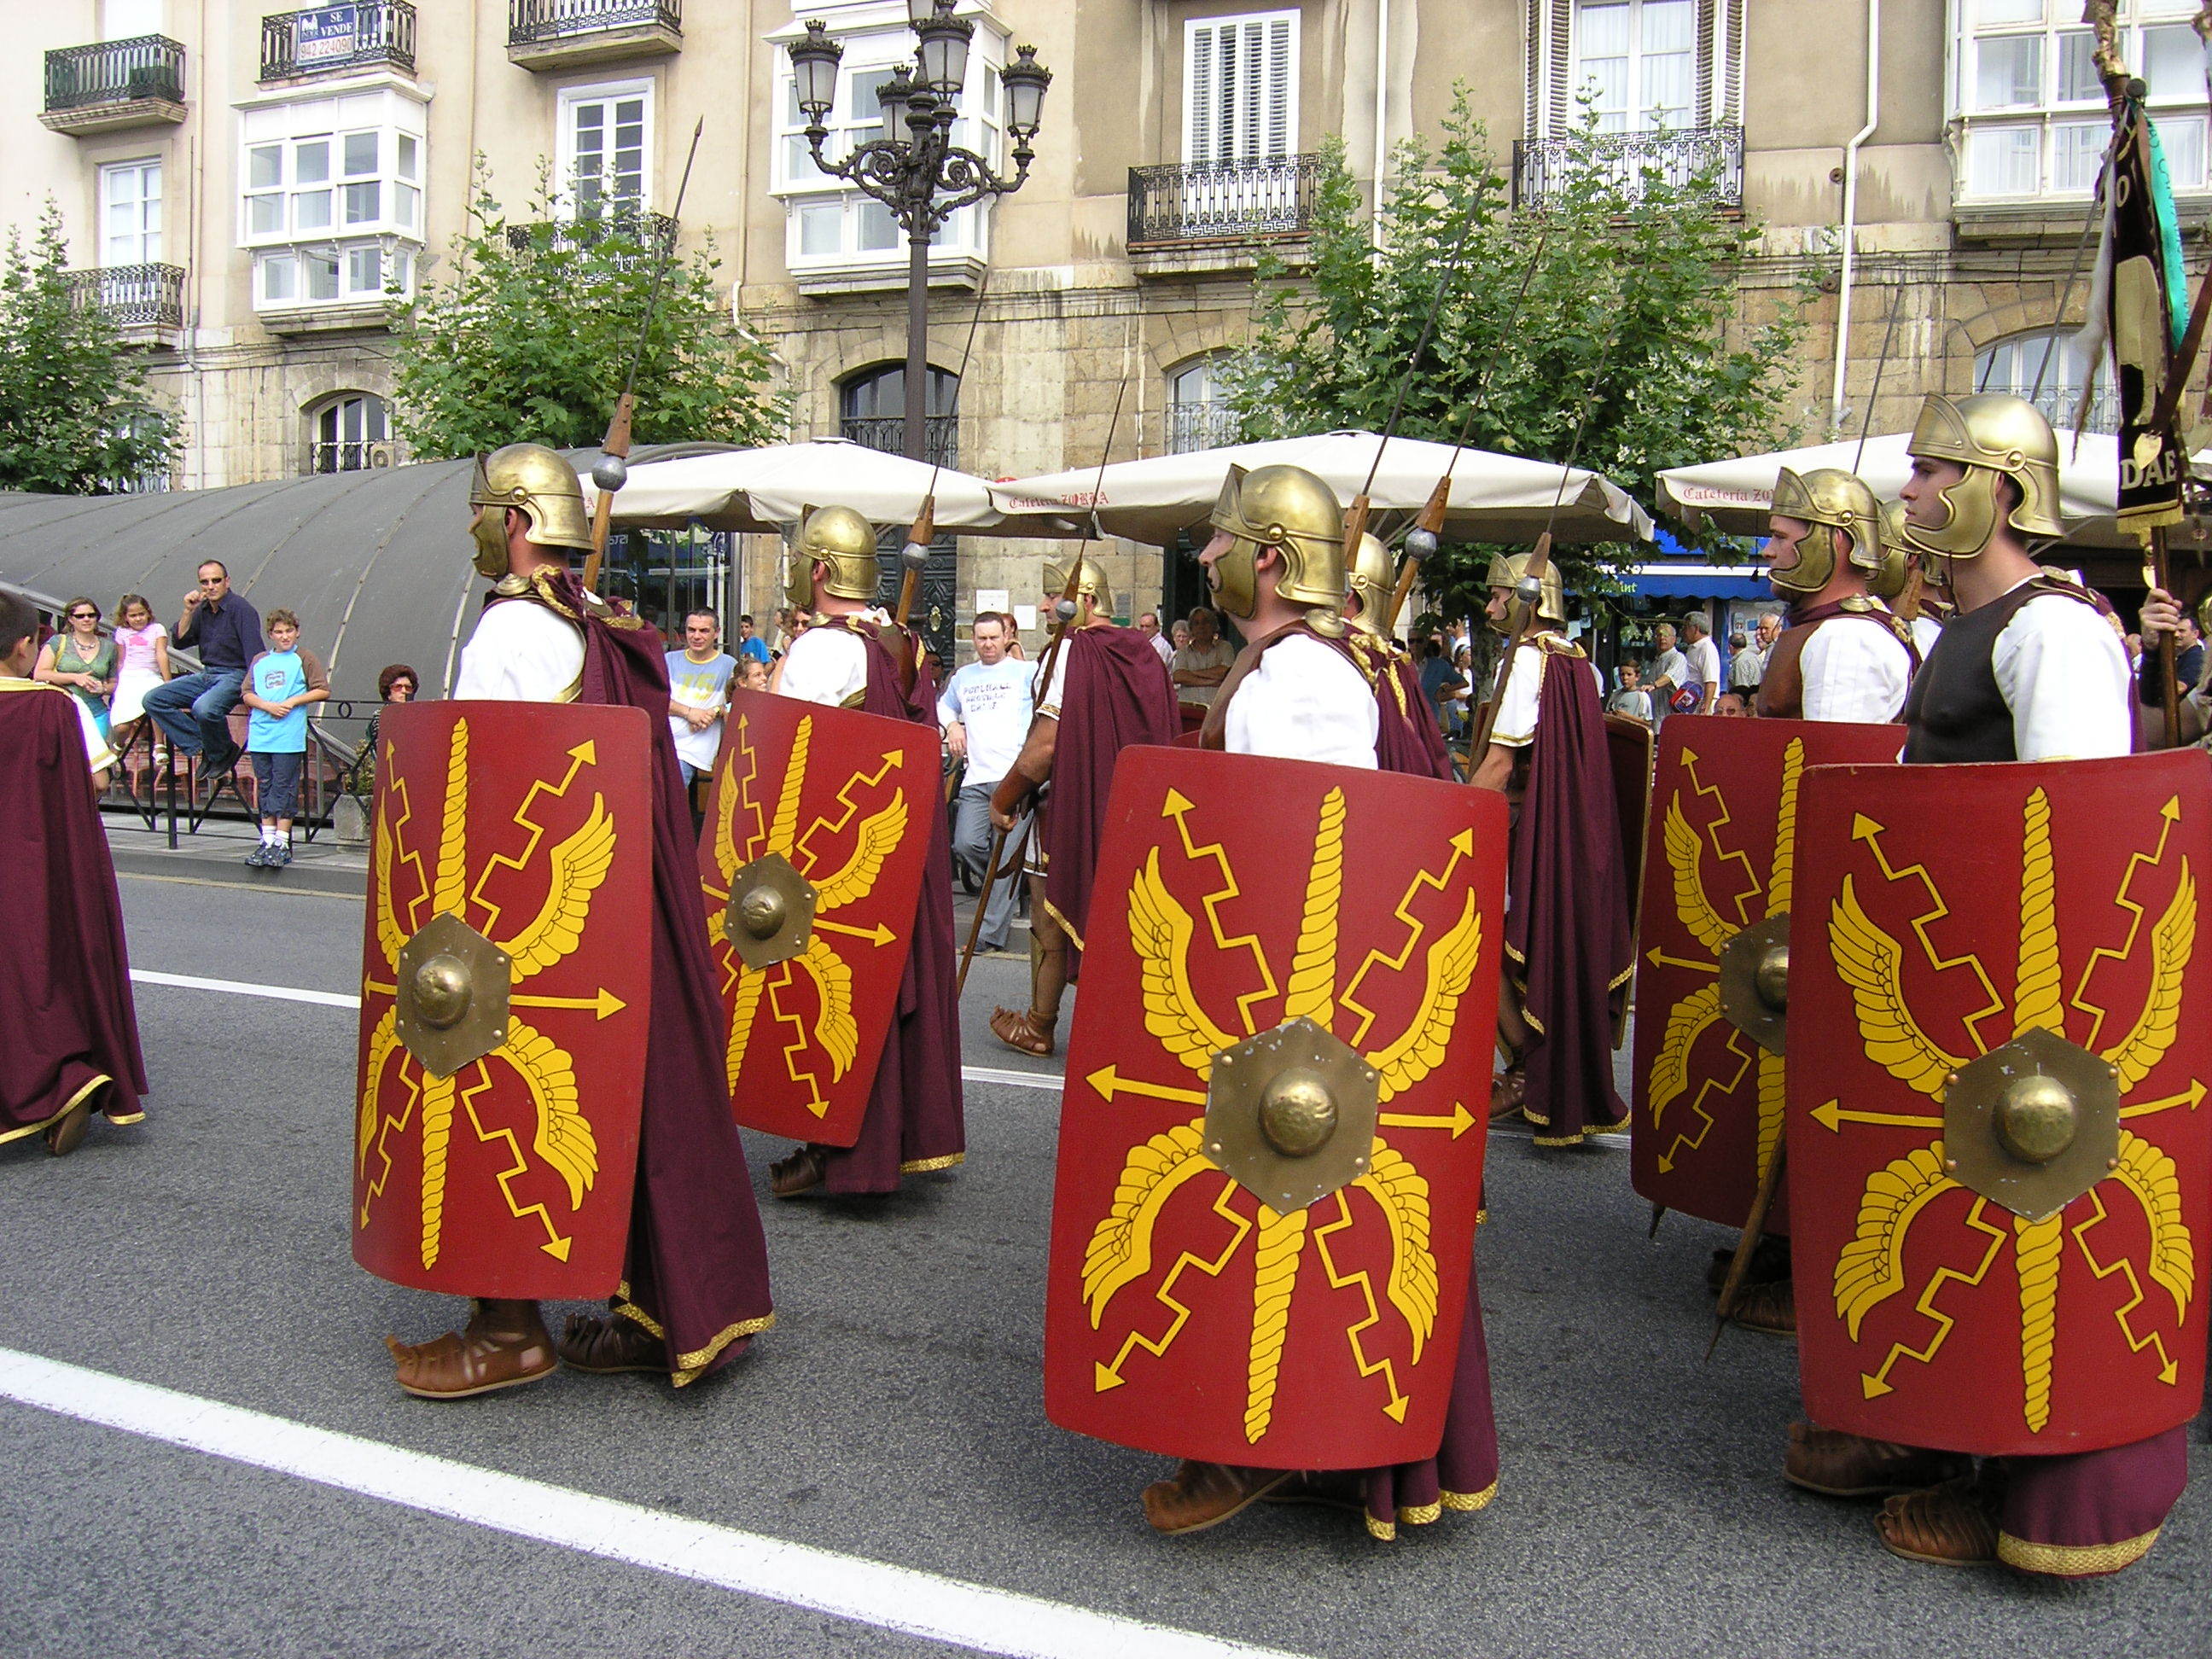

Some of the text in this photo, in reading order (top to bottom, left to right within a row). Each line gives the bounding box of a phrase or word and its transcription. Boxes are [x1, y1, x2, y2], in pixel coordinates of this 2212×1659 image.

[329, 11, 343, 22] SE
[320, 22, 352, 36] VENDE
[300, 43, 317, 58] 942
